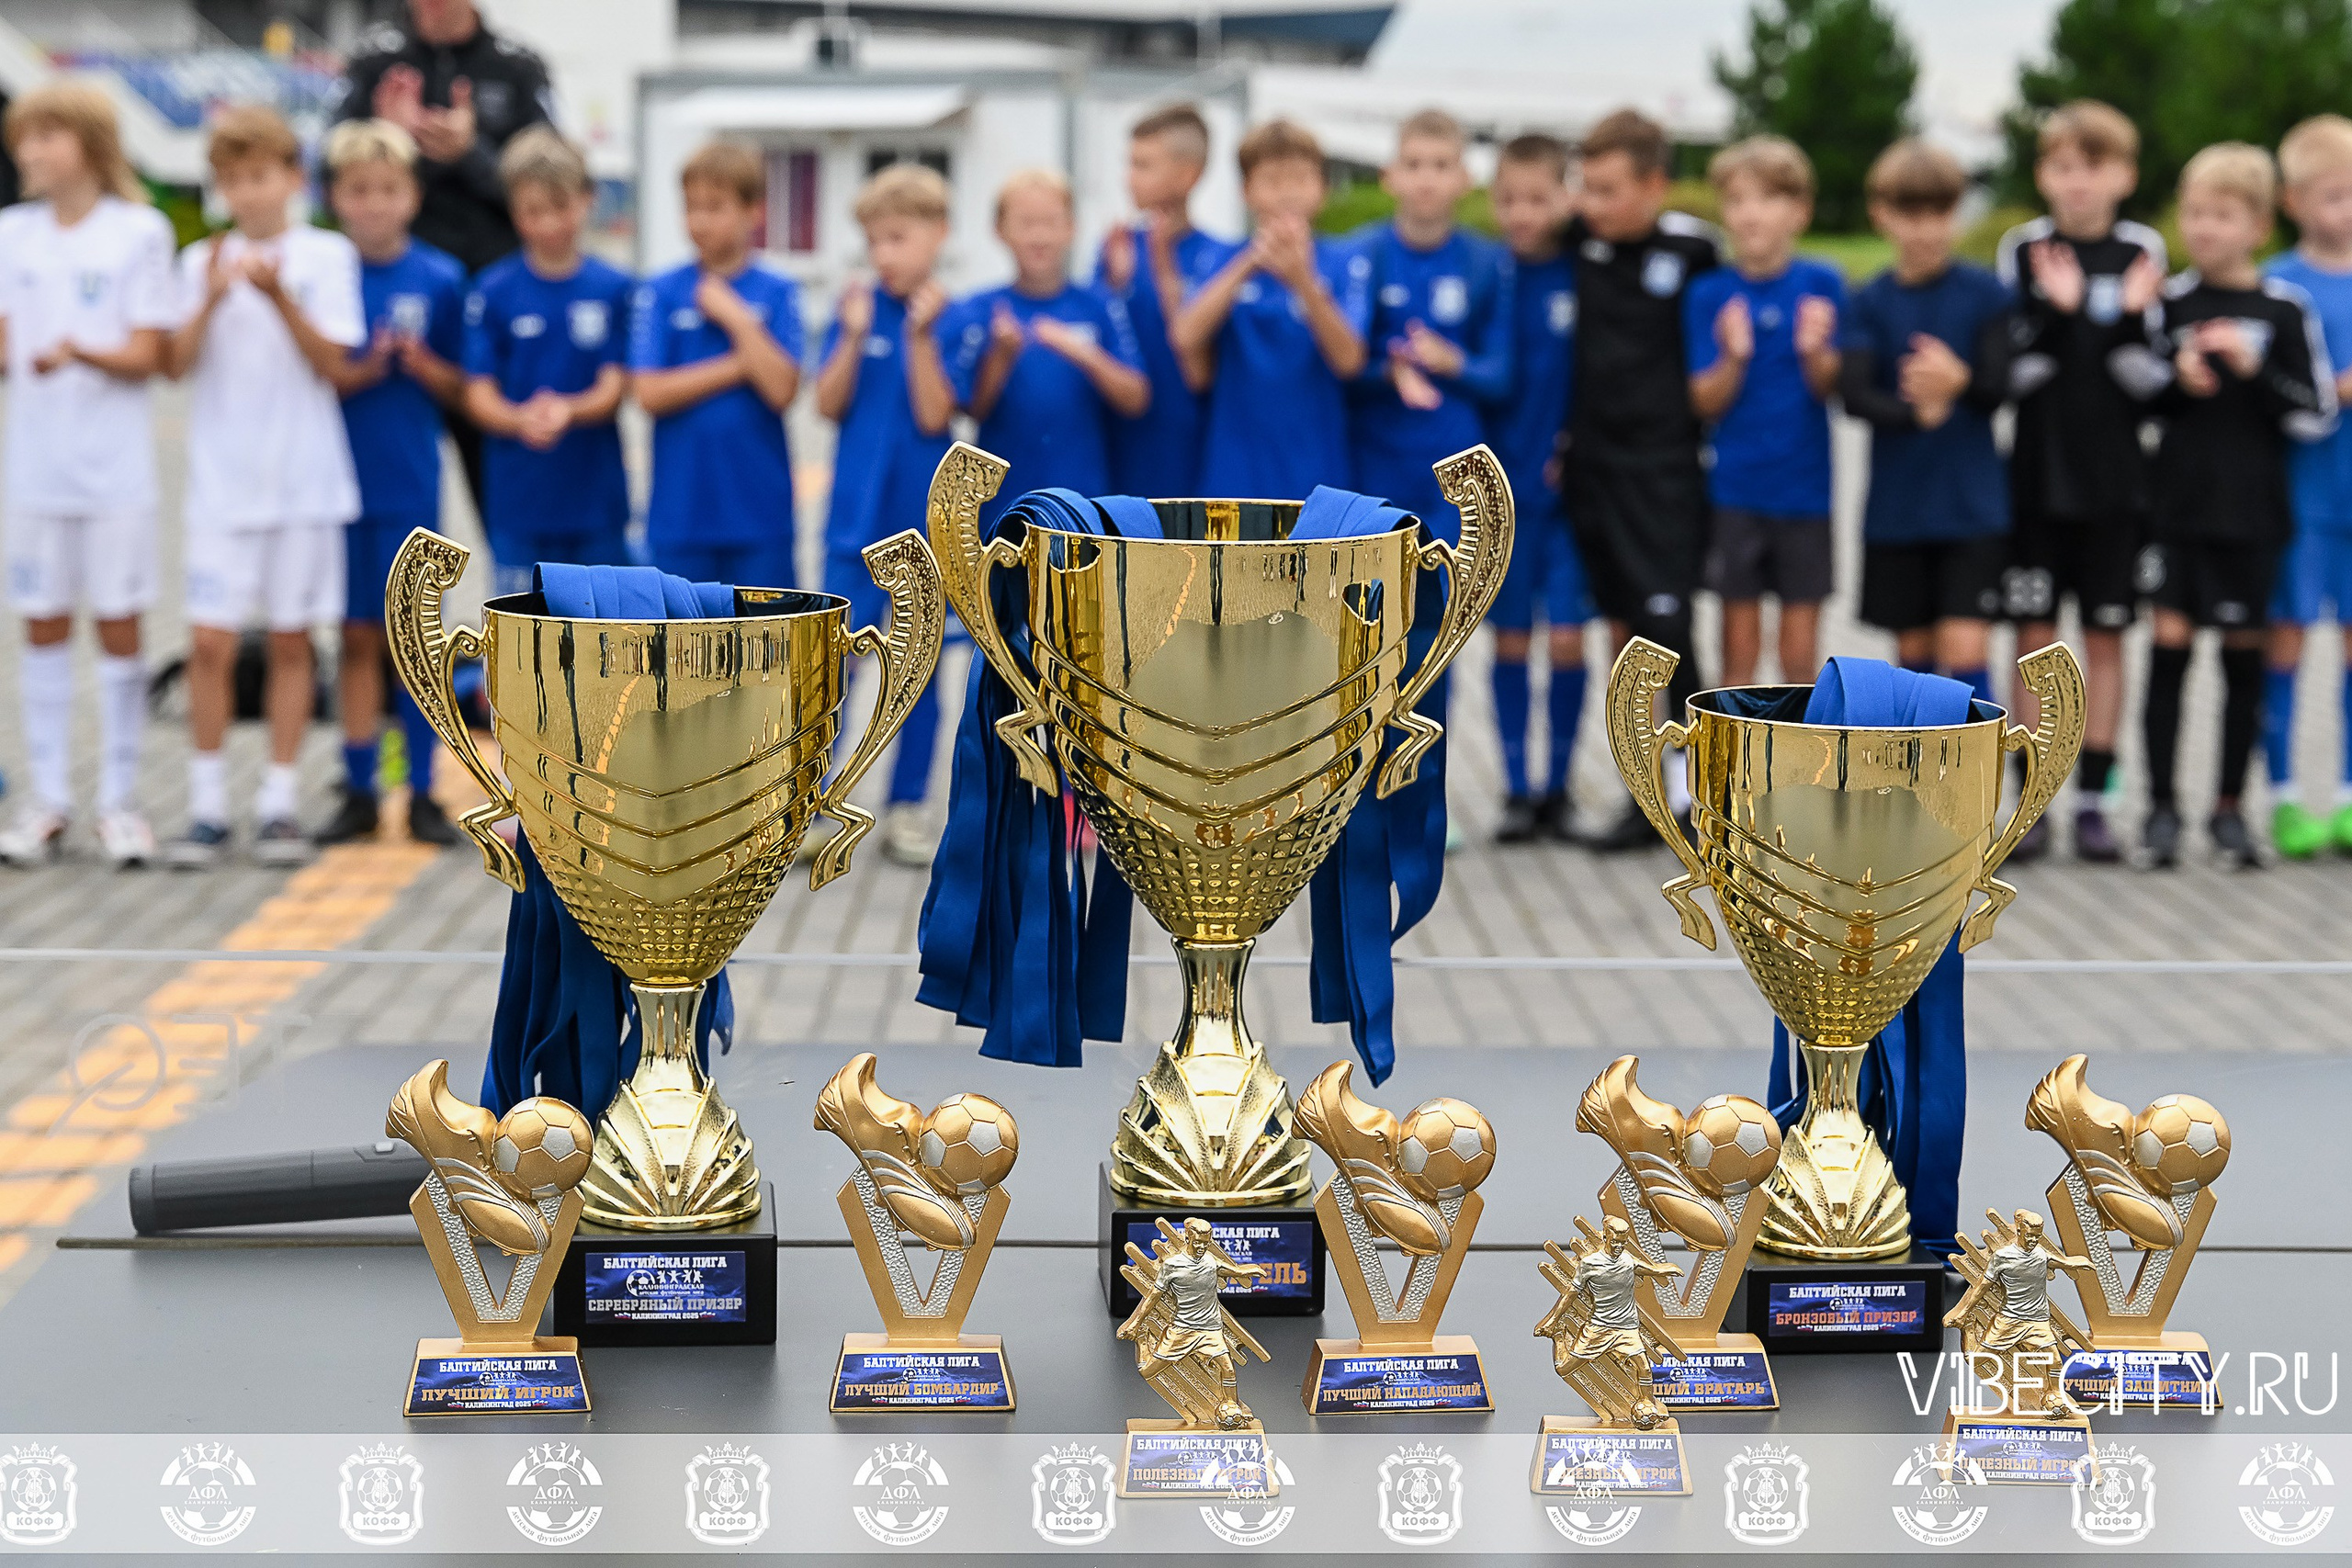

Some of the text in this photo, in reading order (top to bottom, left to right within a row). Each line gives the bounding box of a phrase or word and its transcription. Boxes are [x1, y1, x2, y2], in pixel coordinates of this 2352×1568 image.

[1247, 1227, 1280, 1239] ЛИГА
[603, 1255, 728, 1269] БАЛТИЙСКАЯ ЛИГА
[1789, 1284, 1906, 1299] БАЛТИЙСКАЯ ЛИГА
[588, 1296, 742, 1312] СЕРЕБРЯНЫЙ ПРИЗЕР
[631, 1312, 699, 1321] КАЛИНИНГРАД 2025
[1775, 1310, 1917, 1325] БРОНЗОВЫЙ ПРИЗЕР
[1814, 1324, 1880, 1332] КАЛИНИНГРАД 2025
[439, 1359, 558, 1373] БАЛТИЙСКАЯ ЛИГА
[864, 1355, 980, 1369] БАЛТИЙСКАЯ ЛИГА
[1343, 1359, 1459, 1373] БАЛТИЙСКАЯ ЛИГА
[1713, 1355, 1746, 1368] ЛИГА
[421, 1384, 576, 1402] ЛУЧШИЙ ИГРОК
[844, 1381, 999, 1396] ЛУЧШИЙ БОМБАРДИР
[1322, 1385, 1382, 1402] ЛУЧШИЙ
[1385, 1382, 1482, 1400] НАПАДАЮЩИЙ
[1694, 1382, 1766, 1395] ВРАТАРЬ
[464, 1400, 532, 1409] КАЛИНИНГРАД 2025
[888, 1396, 938, 1404] КАЛИНИНГРАД
[1370, 1400, 1419, 1408] КАЛИНИНГРАД
[1962, 1427, 2084, 1442] БАЛТИЙСКАЯ ЛИГА
[1136, 1437, 1222, 1450] БАЛТИЙСКАЯ
[1638, 1438, 1674, 1450] ЛИГА
[1959, 1456, 2038, 1471] ПЛЕЗНЫЙ
[1133, 1466, 1209, 1482] ПОЛЕЗНЫ
[1985, 1471, 2040, 1480] КАЛИНИНГРАД
